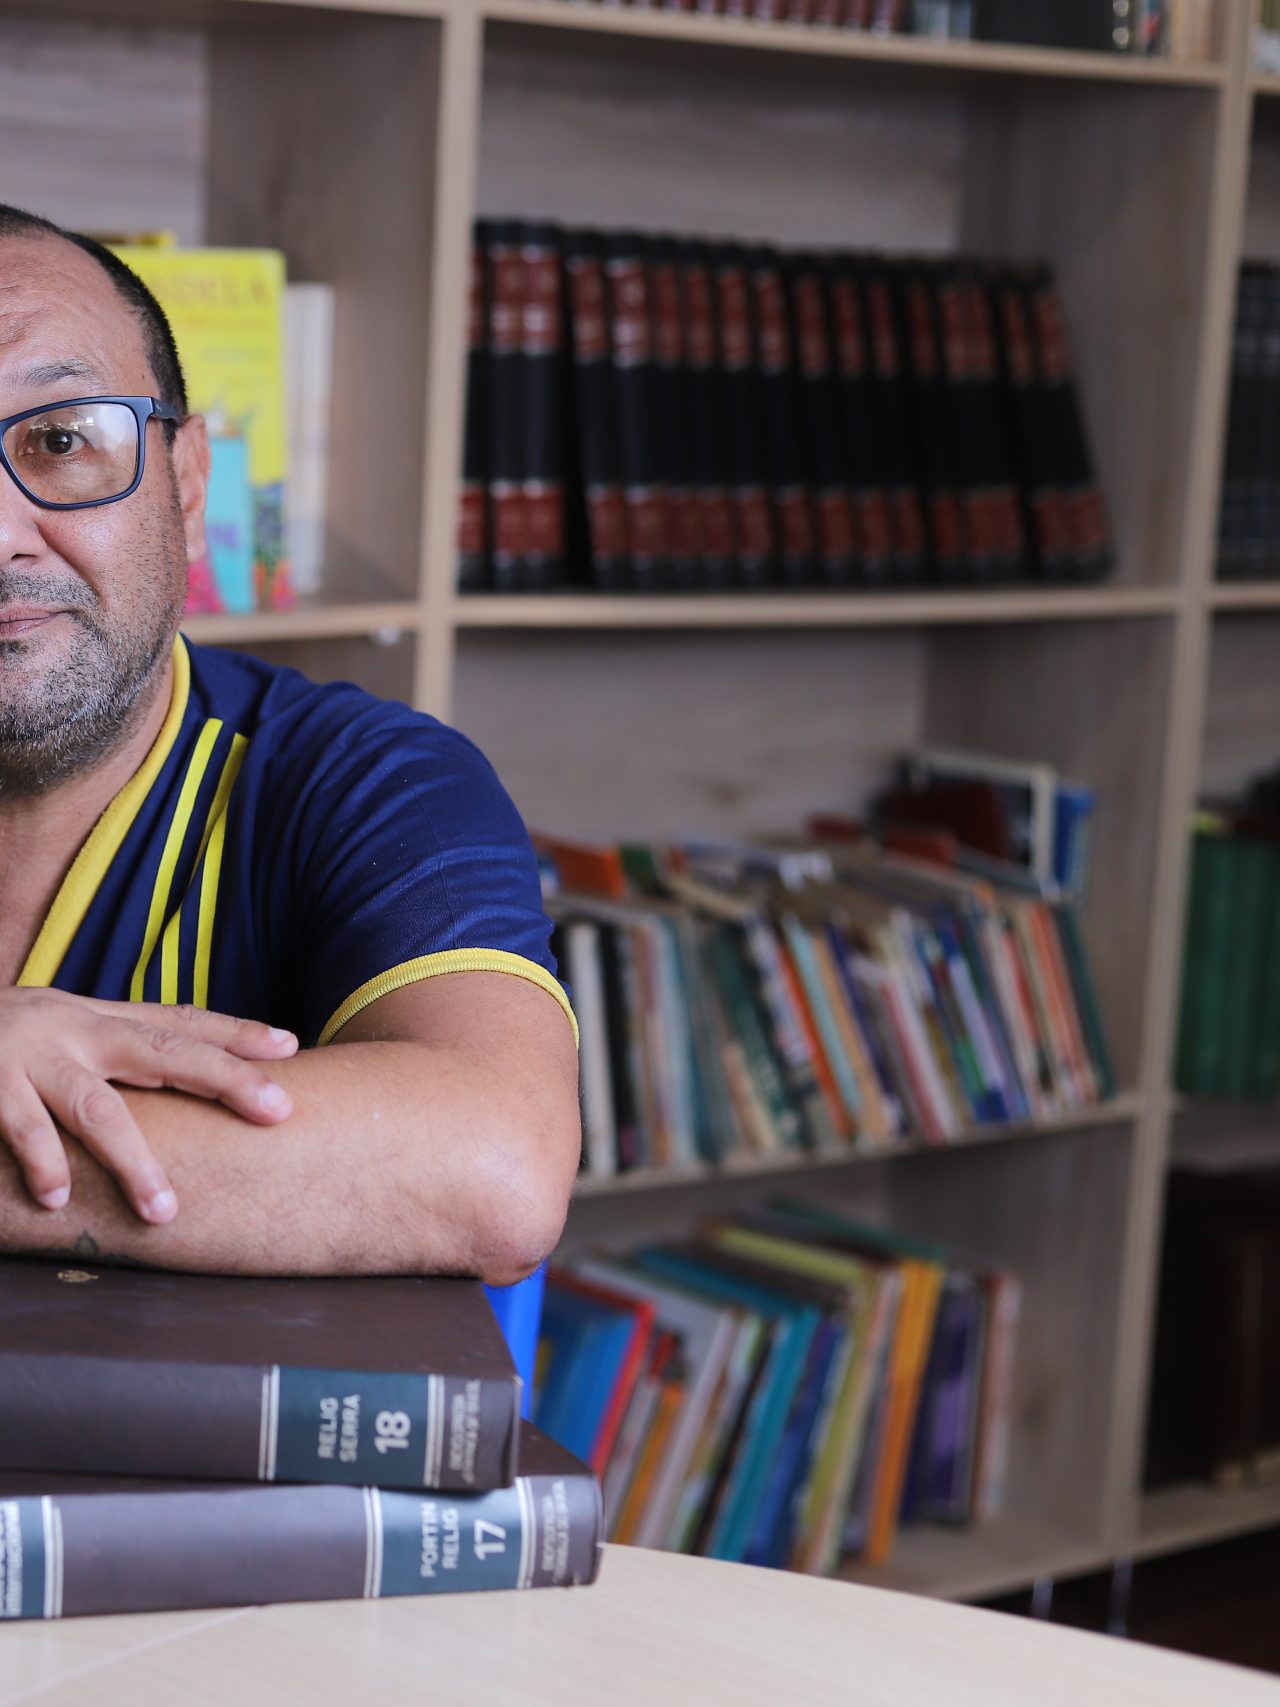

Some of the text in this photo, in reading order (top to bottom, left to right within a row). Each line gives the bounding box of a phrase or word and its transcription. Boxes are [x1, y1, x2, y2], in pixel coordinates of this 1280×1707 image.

[317, 1396, 339, 1459] RELIG
[338, 1393, 361, 1463] SERRA
[373, 1410, 411, 1455] 18
[420, 1501, 438, 1577] PORTIN
[441, 1506, 459, 1570] RELIG
[473, 1518, 506, 1560] 17
